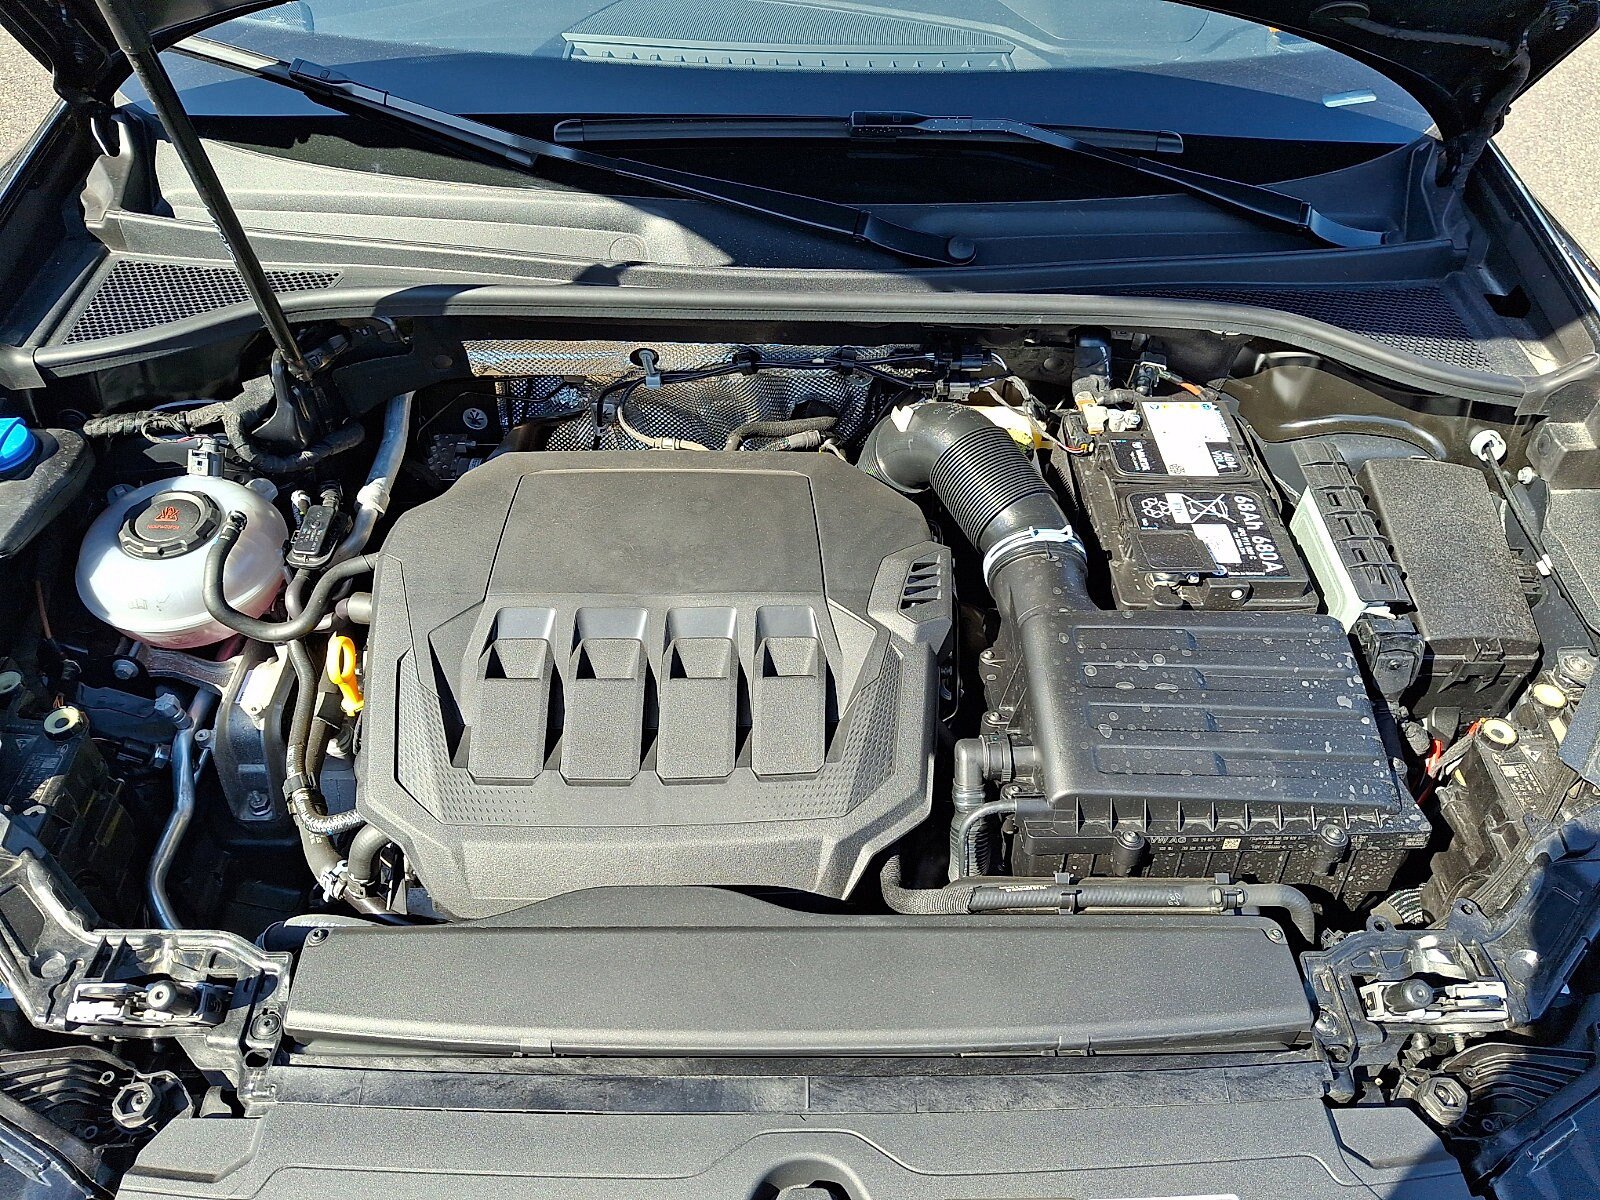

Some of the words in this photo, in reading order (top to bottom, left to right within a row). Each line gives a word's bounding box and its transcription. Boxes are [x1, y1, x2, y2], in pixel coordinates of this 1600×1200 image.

[1211, 450, 1228, 469] VRLA
[1221, 451, 1238, 468] AGM
[1234, 495, 1264, 530] 68Ah
[1251, 535, 1284, 573] 680A
